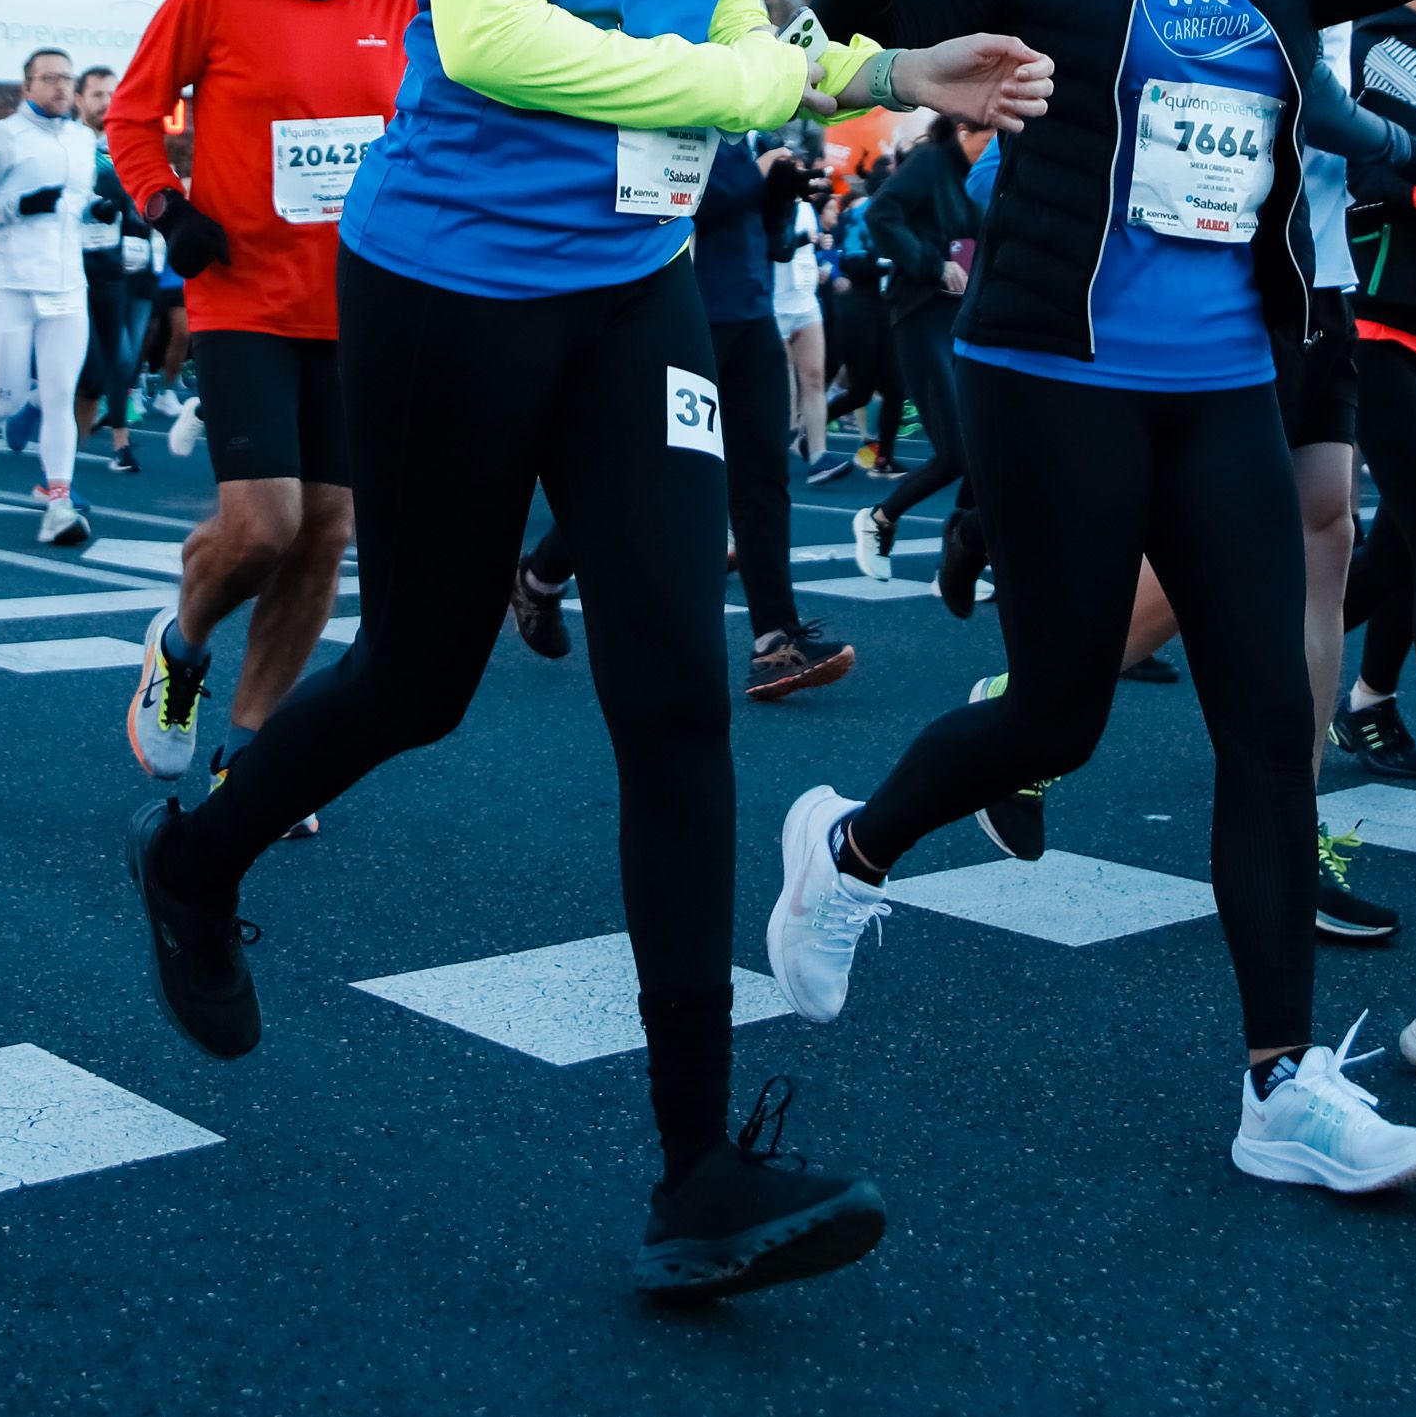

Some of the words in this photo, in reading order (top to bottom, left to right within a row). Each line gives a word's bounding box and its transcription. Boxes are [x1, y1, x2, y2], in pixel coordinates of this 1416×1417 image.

[1163, 14, 1250, 41] CARREFOUR
[1174, 121, 1259, 162] 7664
[669, 170, 701, 184] Sabadell
[1192, 197, 1238, 213] Sabadell
[1196, 217, 1230, 232] MARCA
[675, 388, 717, 433] 37
